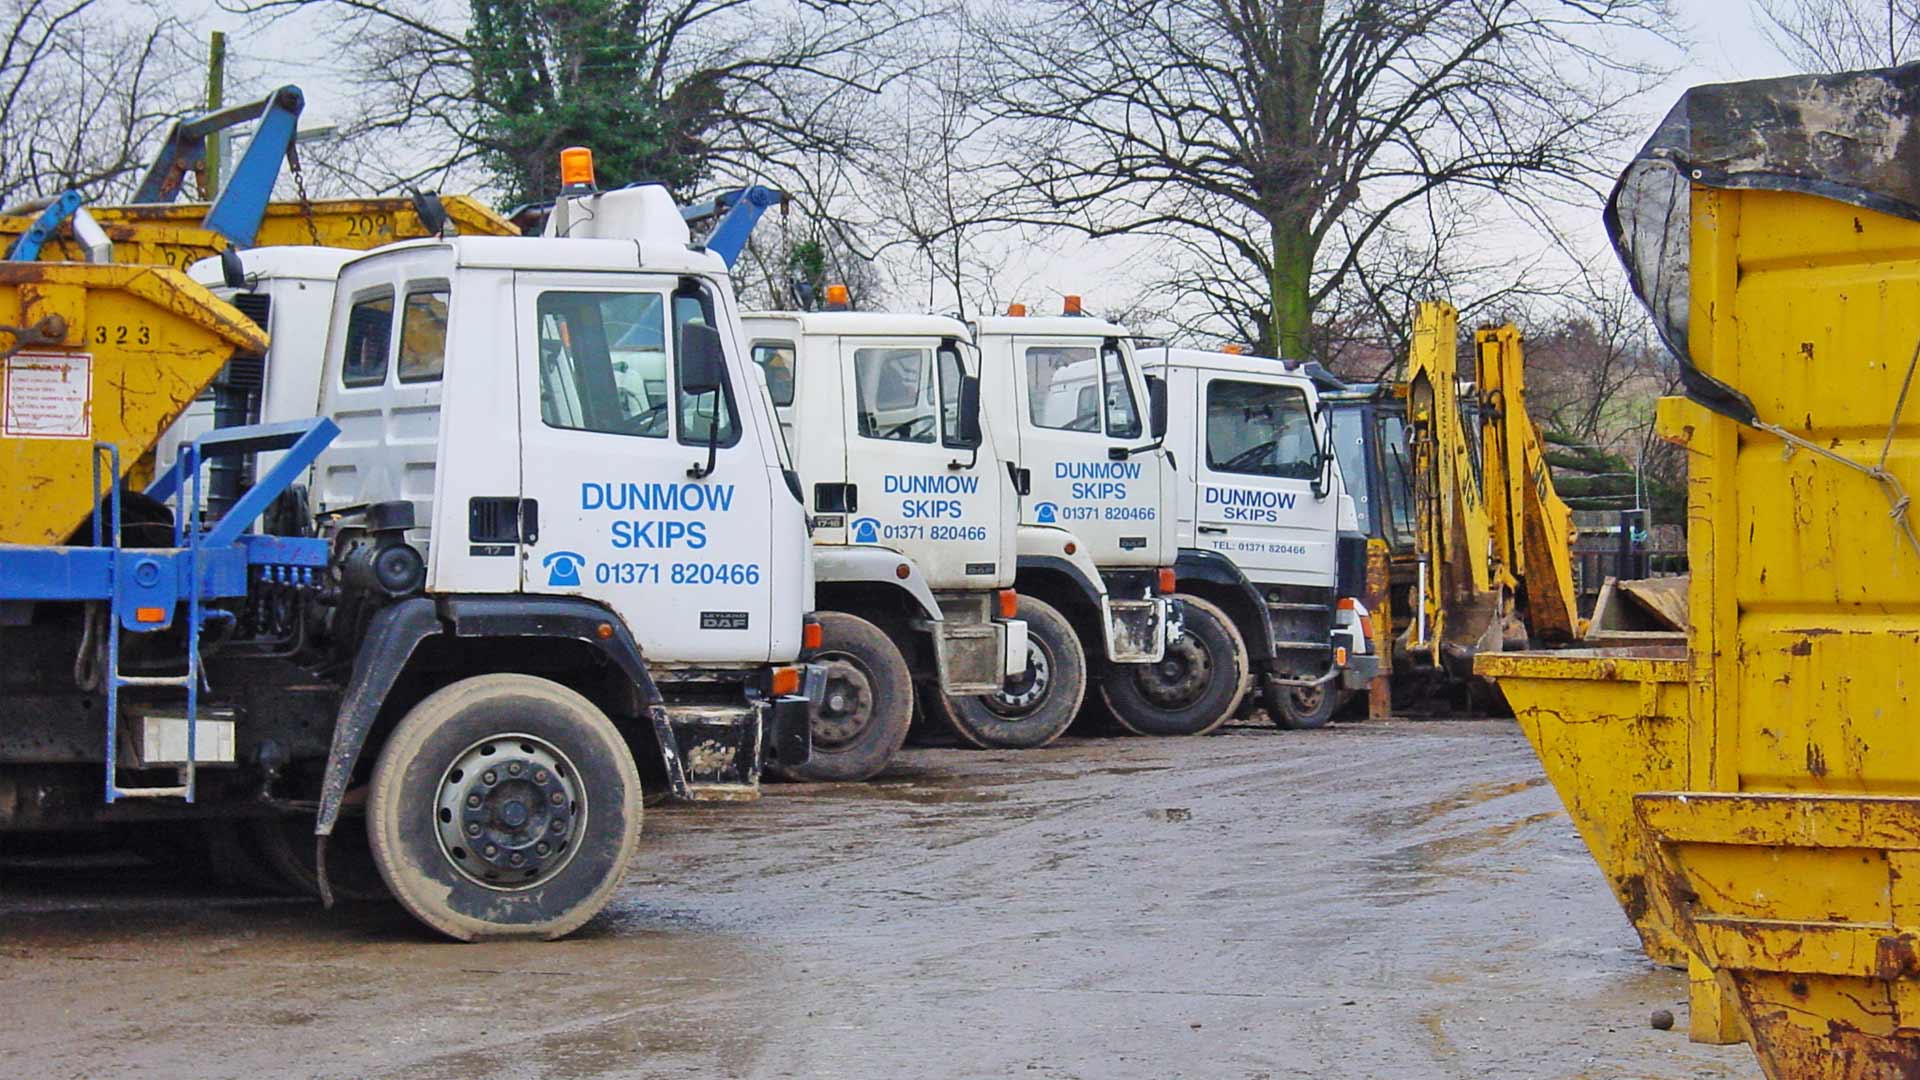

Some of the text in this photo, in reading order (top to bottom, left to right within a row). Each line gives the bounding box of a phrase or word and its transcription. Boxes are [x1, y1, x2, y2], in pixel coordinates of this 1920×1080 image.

[95, 325, 151, 345] 323
[1055, 462, 1142, 480] DUNMOW
[883, 474, 979, 495] DUNMOW
[1071, 482, 1127, 501] SKIPS
[581, 482, 735, 512] DUNMOW
[1205, 487, 1297, 510] DUNMOW
[901, 499, 963, 520] SKIPS
[1062, 507, 1157, 521] 01371 820466
[1223, 506, 1279, 523] SKIPS
[609, 520, 708, 550] SKIPS
[883, 524, 987, 542] 01371 820466
[1213, 541, 1307, 556] TEL: 01371 820466
[594, 562, 761, 586] 01371 820466
[703, 618, 746, 628] DAF
